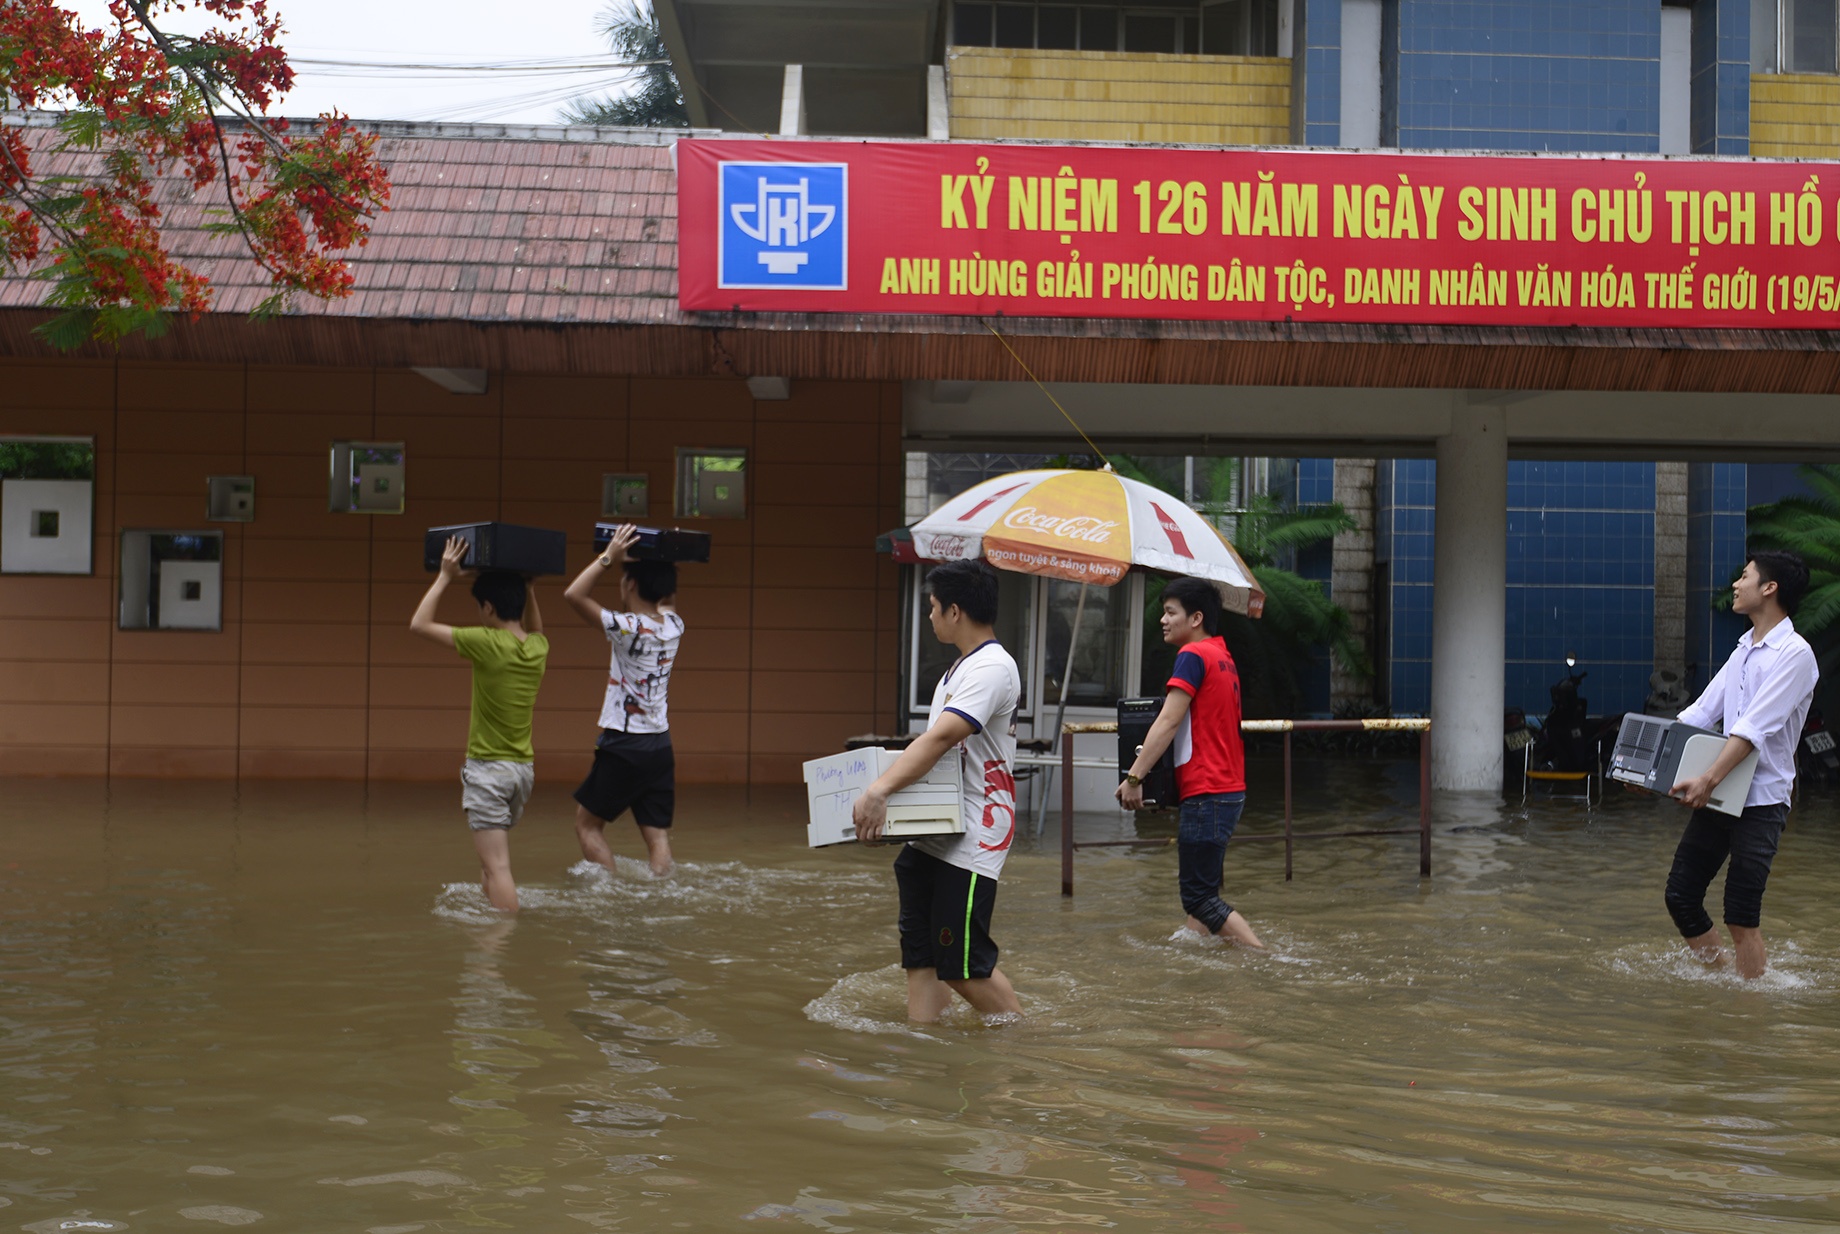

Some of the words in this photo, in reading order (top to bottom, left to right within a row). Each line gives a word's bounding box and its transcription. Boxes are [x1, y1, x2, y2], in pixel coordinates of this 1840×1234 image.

[942, 157, 995, 230] KỶ
[1009, 166, 1118, 245] NIỆM
[1133, 180, 1208, 236] 126
[1222, 171, 1318, 238] NĂM
[1333, 174, 1445, 240] NGÀY
[1458, 186, 1557, 242] SINH
[1571, 171, 1653, 243] CHỦ
[1665, 190, 1756, 257] TỊCH
[1770, 174, 1823, 247] HỒ
[880, 258, 940, 295] ANH
[949, 252, 1027, 298] HÙNG
[1037, 250, 1093, 298] GIẢI
[1102, 256, 1199, 301] PHÓNG
[1207, 257, 1266, 302] DÂN
[1274, 260, 1335, 312] TỘC,
[1344, 268, 1421, 305] DANH
[1429, 263, 1507, 307] NHÂN
[1516, 263, 1572, 307] VĂN
[1581, 264, 1636, 308] HÓA
[1644, 262, 1697, 309] THẾ
[1703, 264, 1757, 311] GIỚI
[987, 548, 1017, 561] ngon
[1018, 552, 1048, 567] tuyệt
[1049, 556, 1059, 567] &
[1059, 557, 1088, 574] sảng
[1088, 562, 1121, 578] khoái
